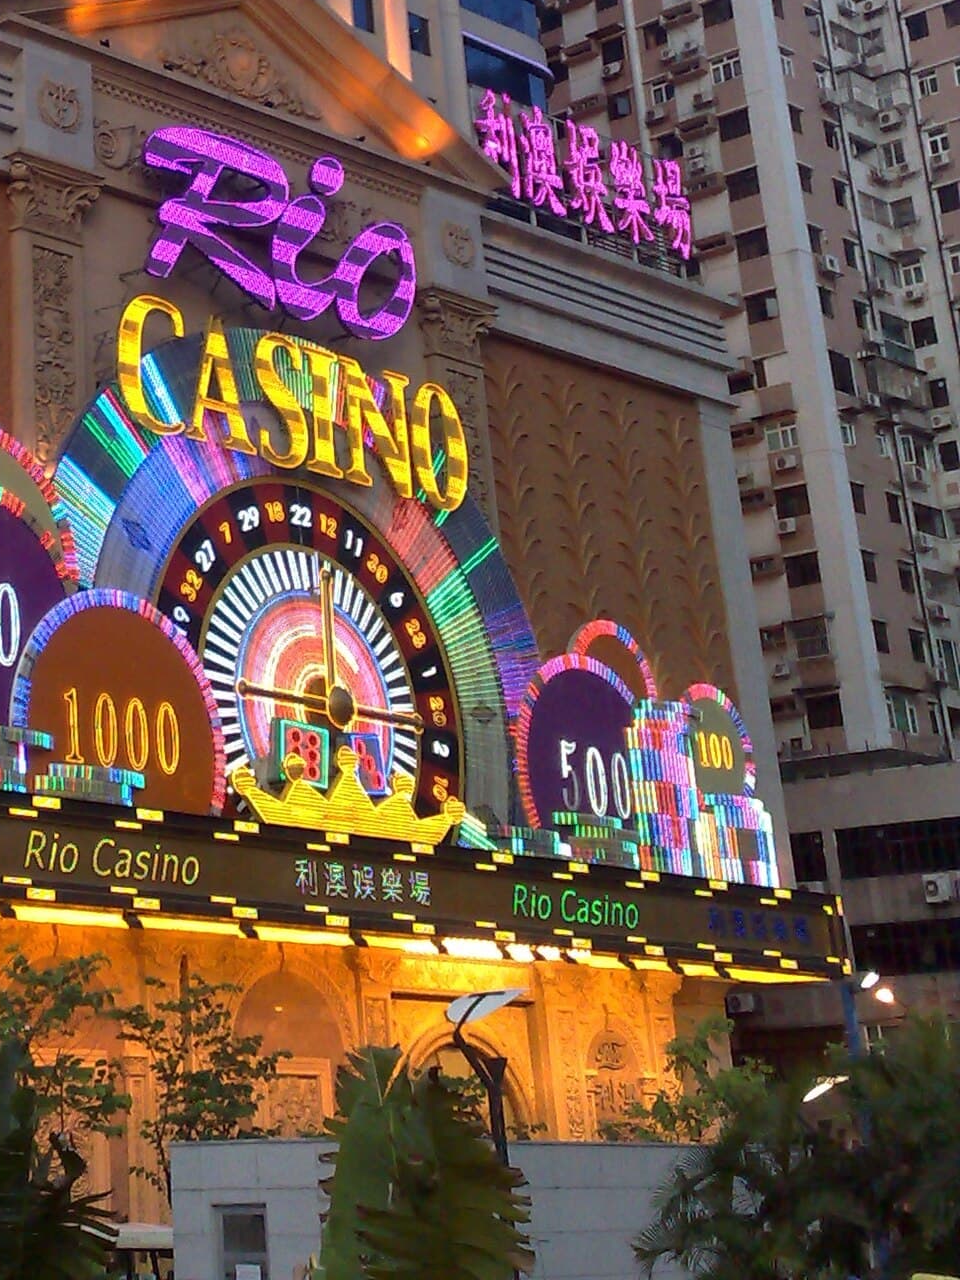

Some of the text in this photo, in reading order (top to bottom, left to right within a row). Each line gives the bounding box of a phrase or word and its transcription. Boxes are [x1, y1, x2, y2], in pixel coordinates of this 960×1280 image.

[144, 127, 417, 340] Rio
[116, 294, 469, 512] CASINO
[237, 505, 260, 532] 29
[290, 504, 312, 528] 22
[319, 513, 338, 539] 12
[195, 539, 216, 572] 27
[345, 529, 363, 558] 11
[180, 569, 203, 602] 32
[63, 686, 181, 775] 1000
[697, 731, 734, 771] 100
[559, 739, 633, 820] 500
[23, 829, 201, 886] Rio Casino
[513, 884, 639, 929] Rio Casino
